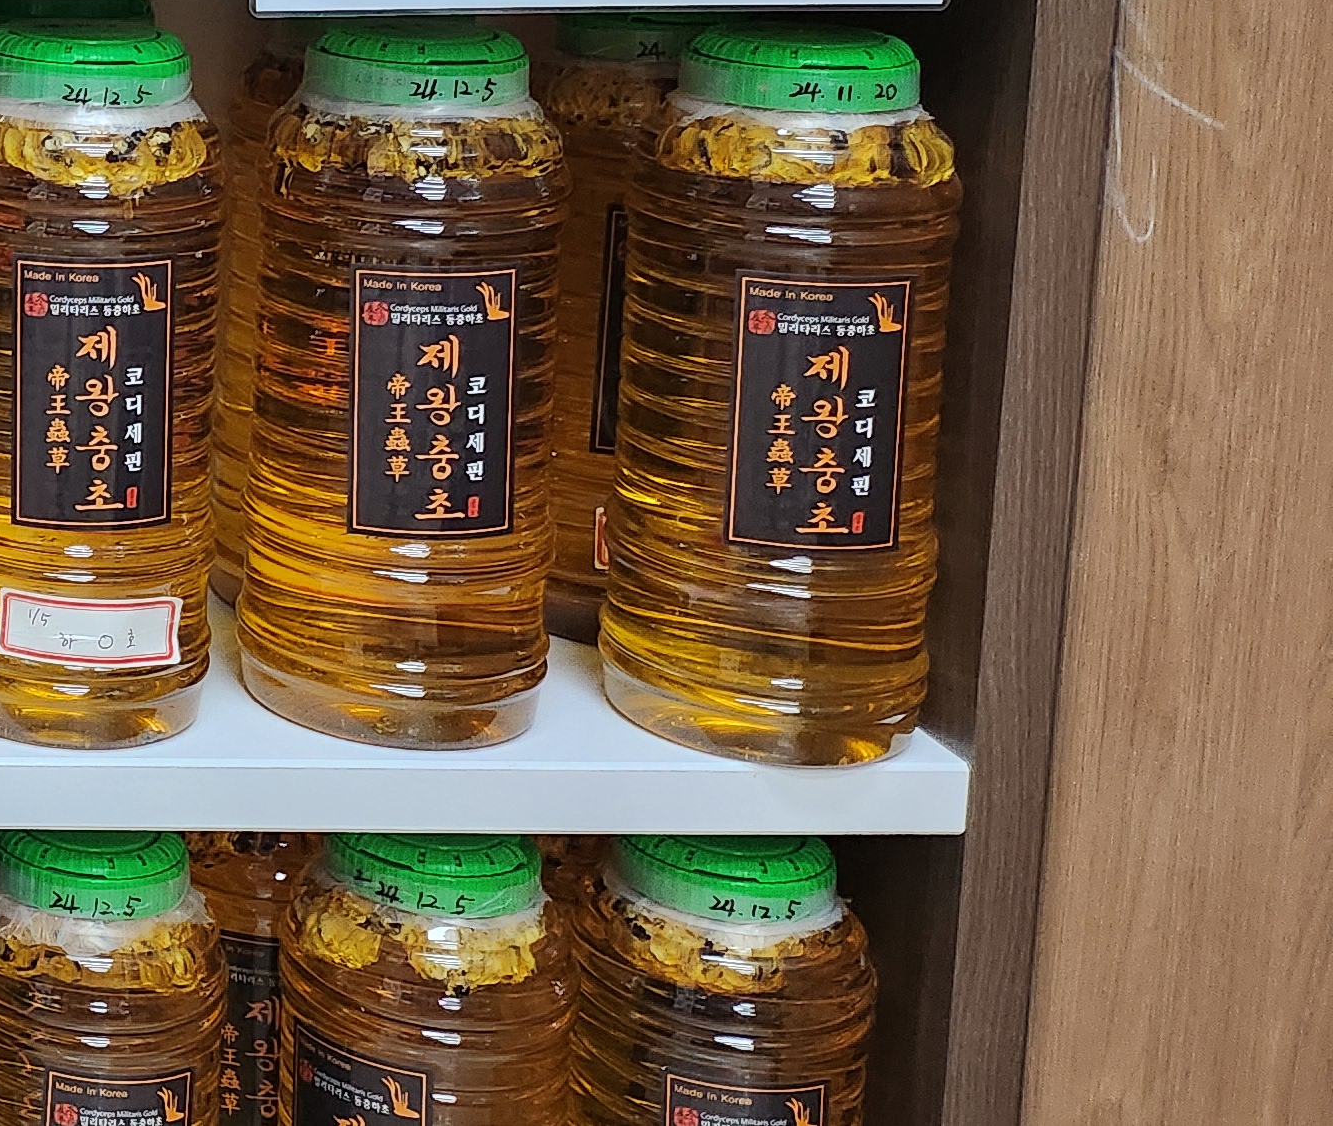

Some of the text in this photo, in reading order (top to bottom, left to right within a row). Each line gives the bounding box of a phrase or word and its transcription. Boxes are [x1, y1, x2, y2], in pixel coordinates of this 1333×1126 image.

[74, 324, 125, 512] 제왕충초
[466, 375, 488, 482] 코디세핀
[794, 345, 851, 535] 제왕충초
